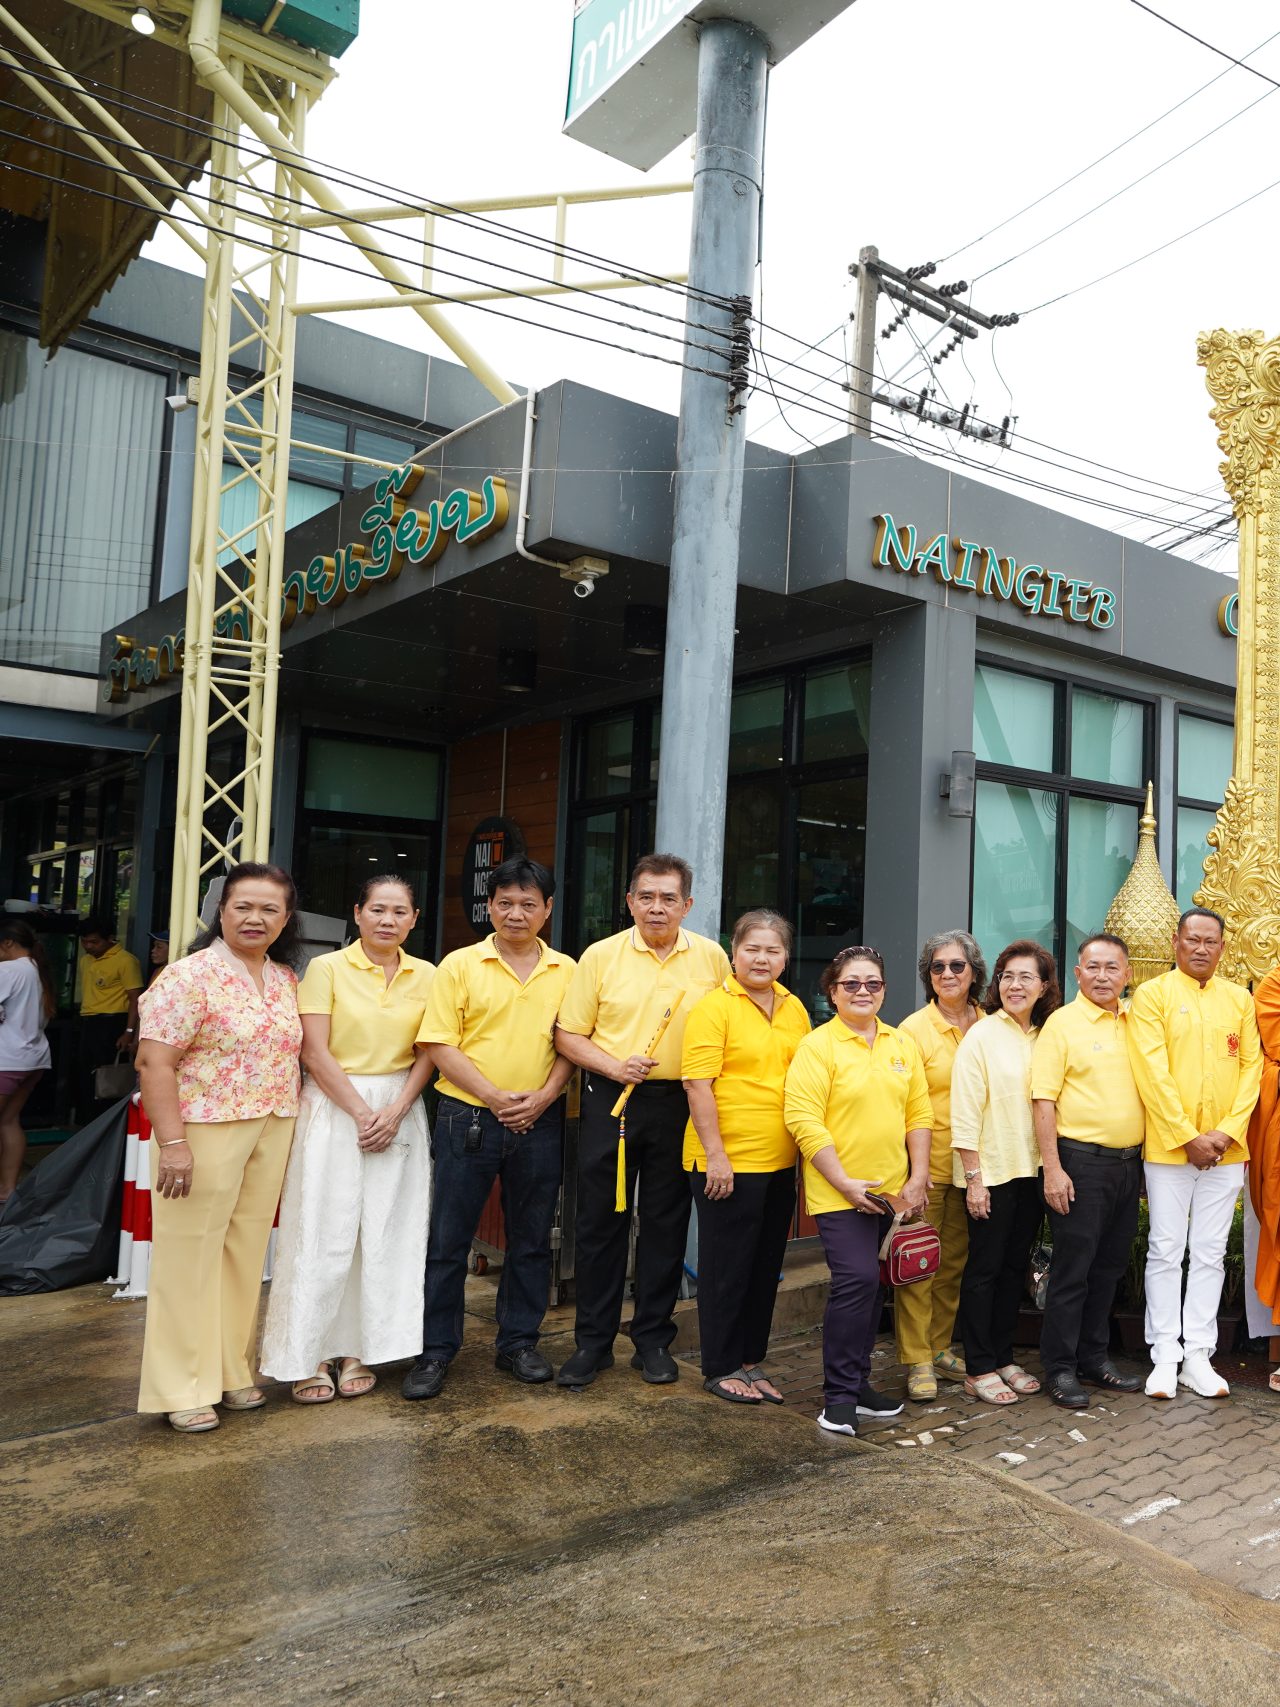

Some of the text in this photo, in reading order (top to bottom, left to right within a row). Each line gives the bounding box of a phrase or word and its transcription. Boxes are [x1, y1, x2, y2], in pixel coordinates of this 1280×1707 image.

[576, 0, 681, 100] กาแ
[877, 513, 1117, 630] NAINGIEB
[474, 842, 491, 868] NAI
[473, 871, 492, 897] NGI
[472, 903, 491, 923] COFF
